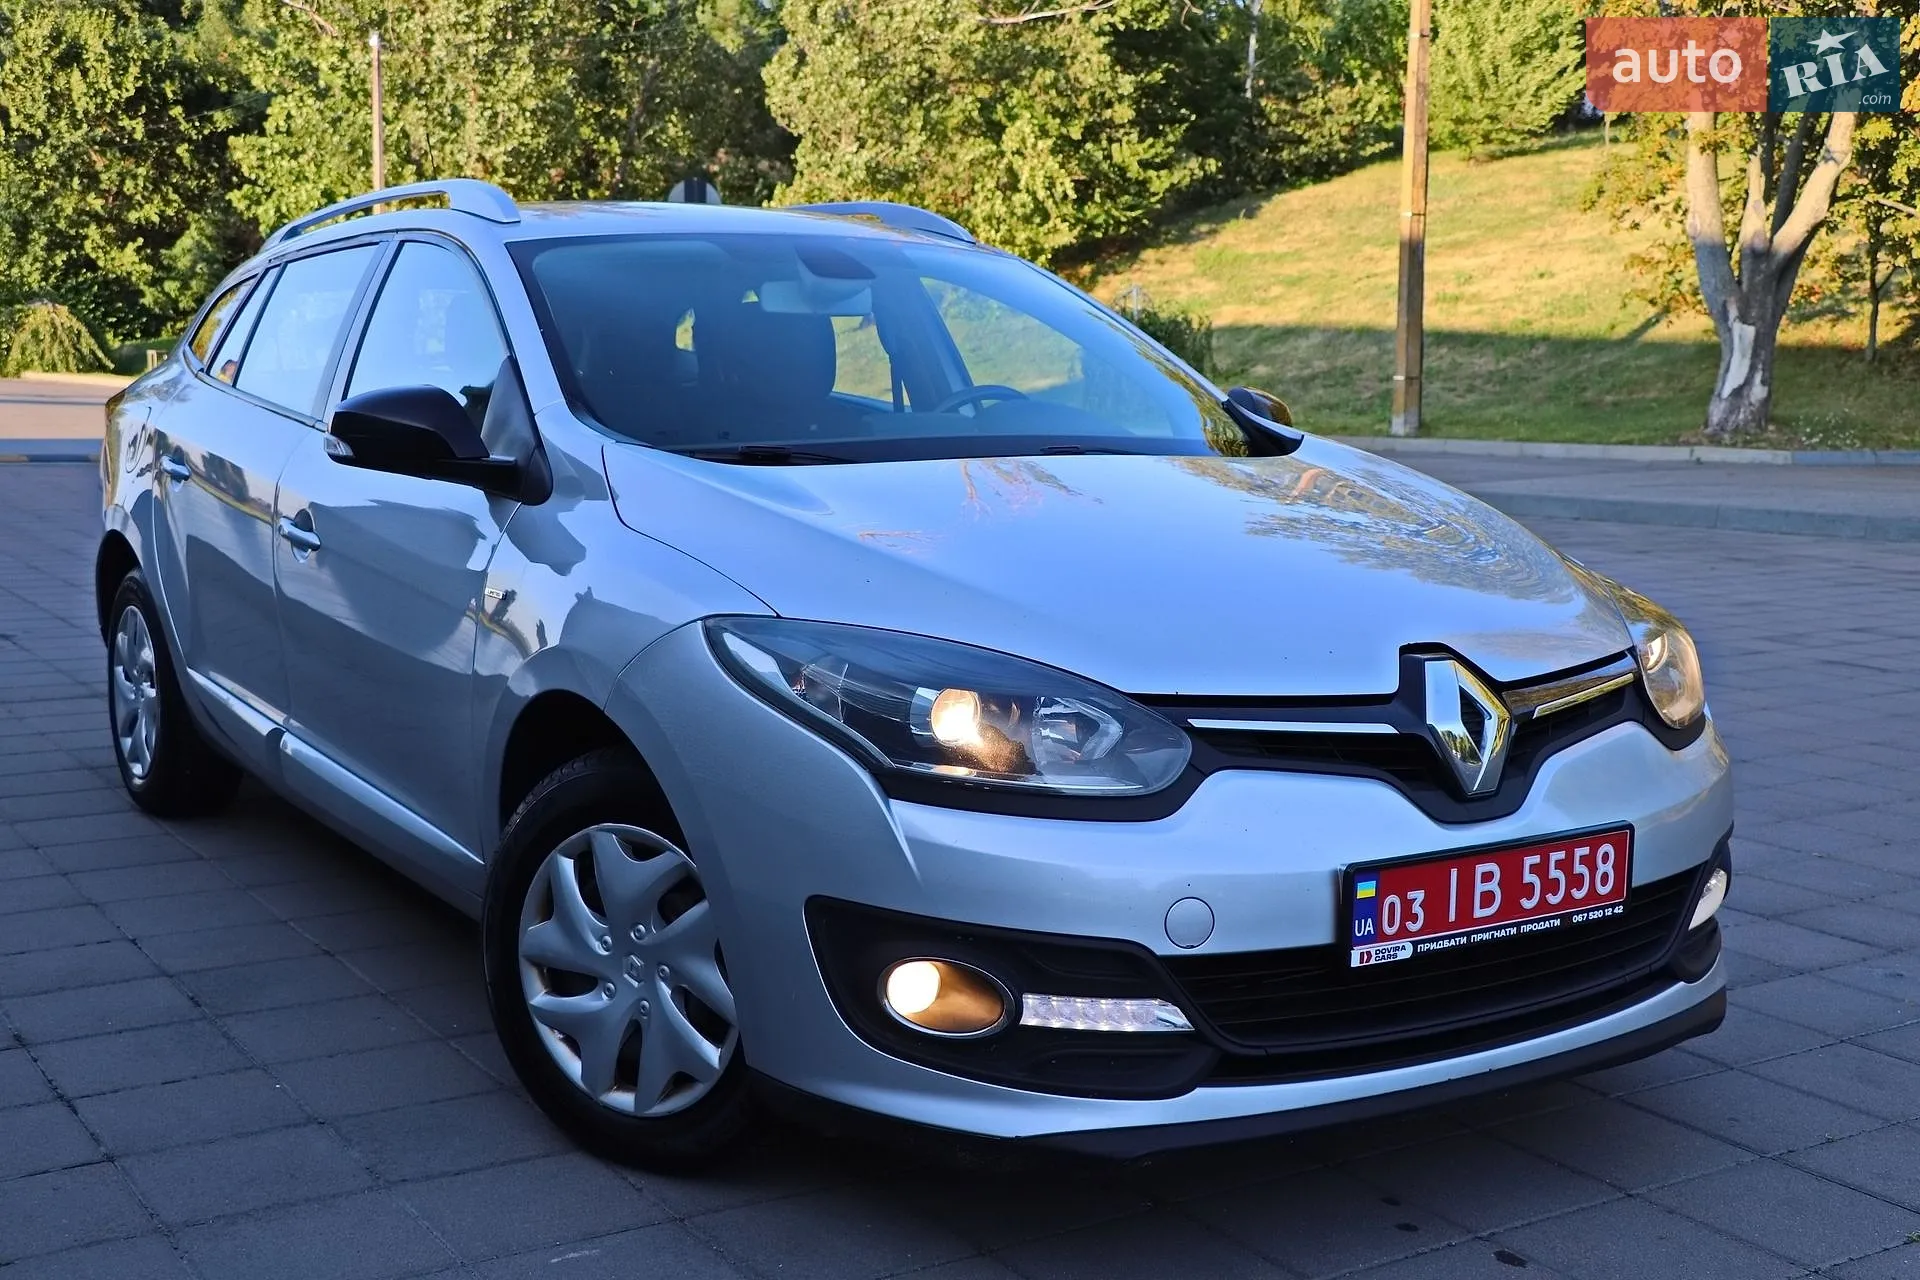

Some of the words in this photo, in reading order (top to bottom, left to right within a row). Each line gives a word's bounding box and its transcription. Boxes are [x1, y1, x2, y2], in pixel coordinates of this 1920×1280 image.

[1382, 890, 1425, 936] 03
[1519, 843, 1615, 910] 5558
[1604, 907, 1612, 917] 12
[1355, 918, 1374, 936] UA
[1417, 936, 1467, 953] ПРИДБАТИ
[1471, 927, 1517, 942] ПРИГНАТИ
[1521, 918, 1561, 933] ПРОДАТИ
[1374, 944, 1407, 956] DOVIRA
[1374, 952, 1399, 962] CARS
